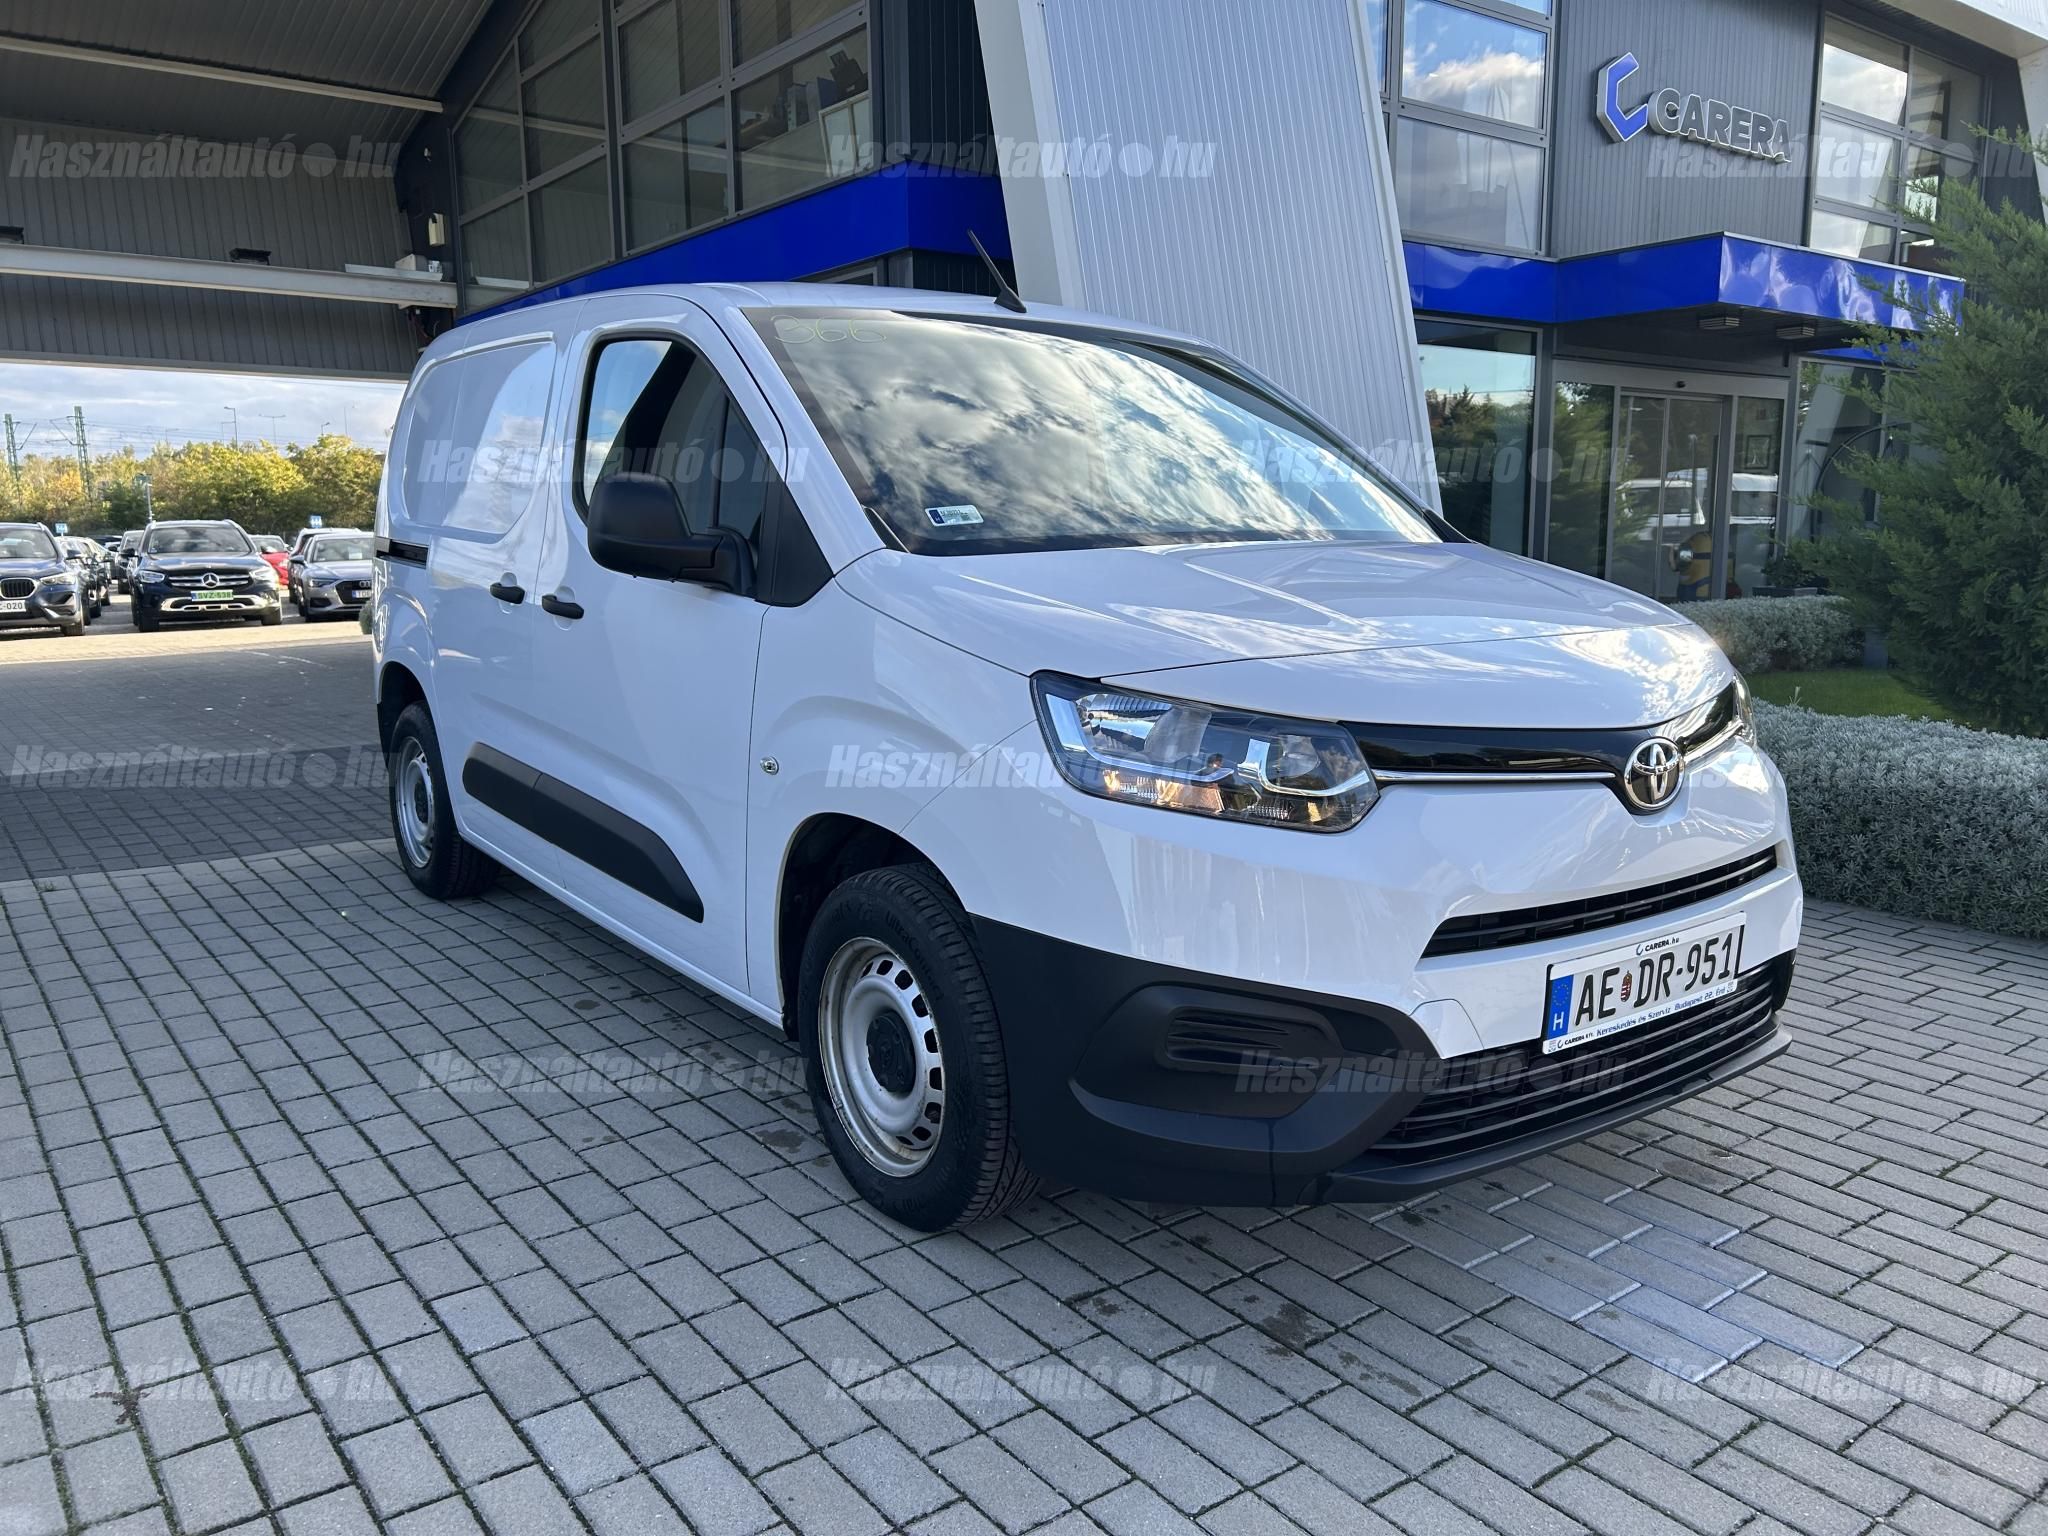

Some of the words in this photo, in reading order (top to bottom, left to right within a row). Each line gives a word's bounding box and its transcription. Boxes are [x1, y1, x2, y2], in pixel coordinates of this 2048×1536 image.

[1650, 87, 1792, 163] CARERA
[1645, 937, 1679, 951] CARERA.hu
[1575, 967, 1620, 1026] AE
[1633, 932, 1734, 1008] DR-951
[1552, 1011, 1565, 1031] H
[1596, 1018, 1637, 1036] Kereskedés
[1648, 1007, 1671, 1019] Szerviz
[1674, 996, 1702, 1011] Budapest
